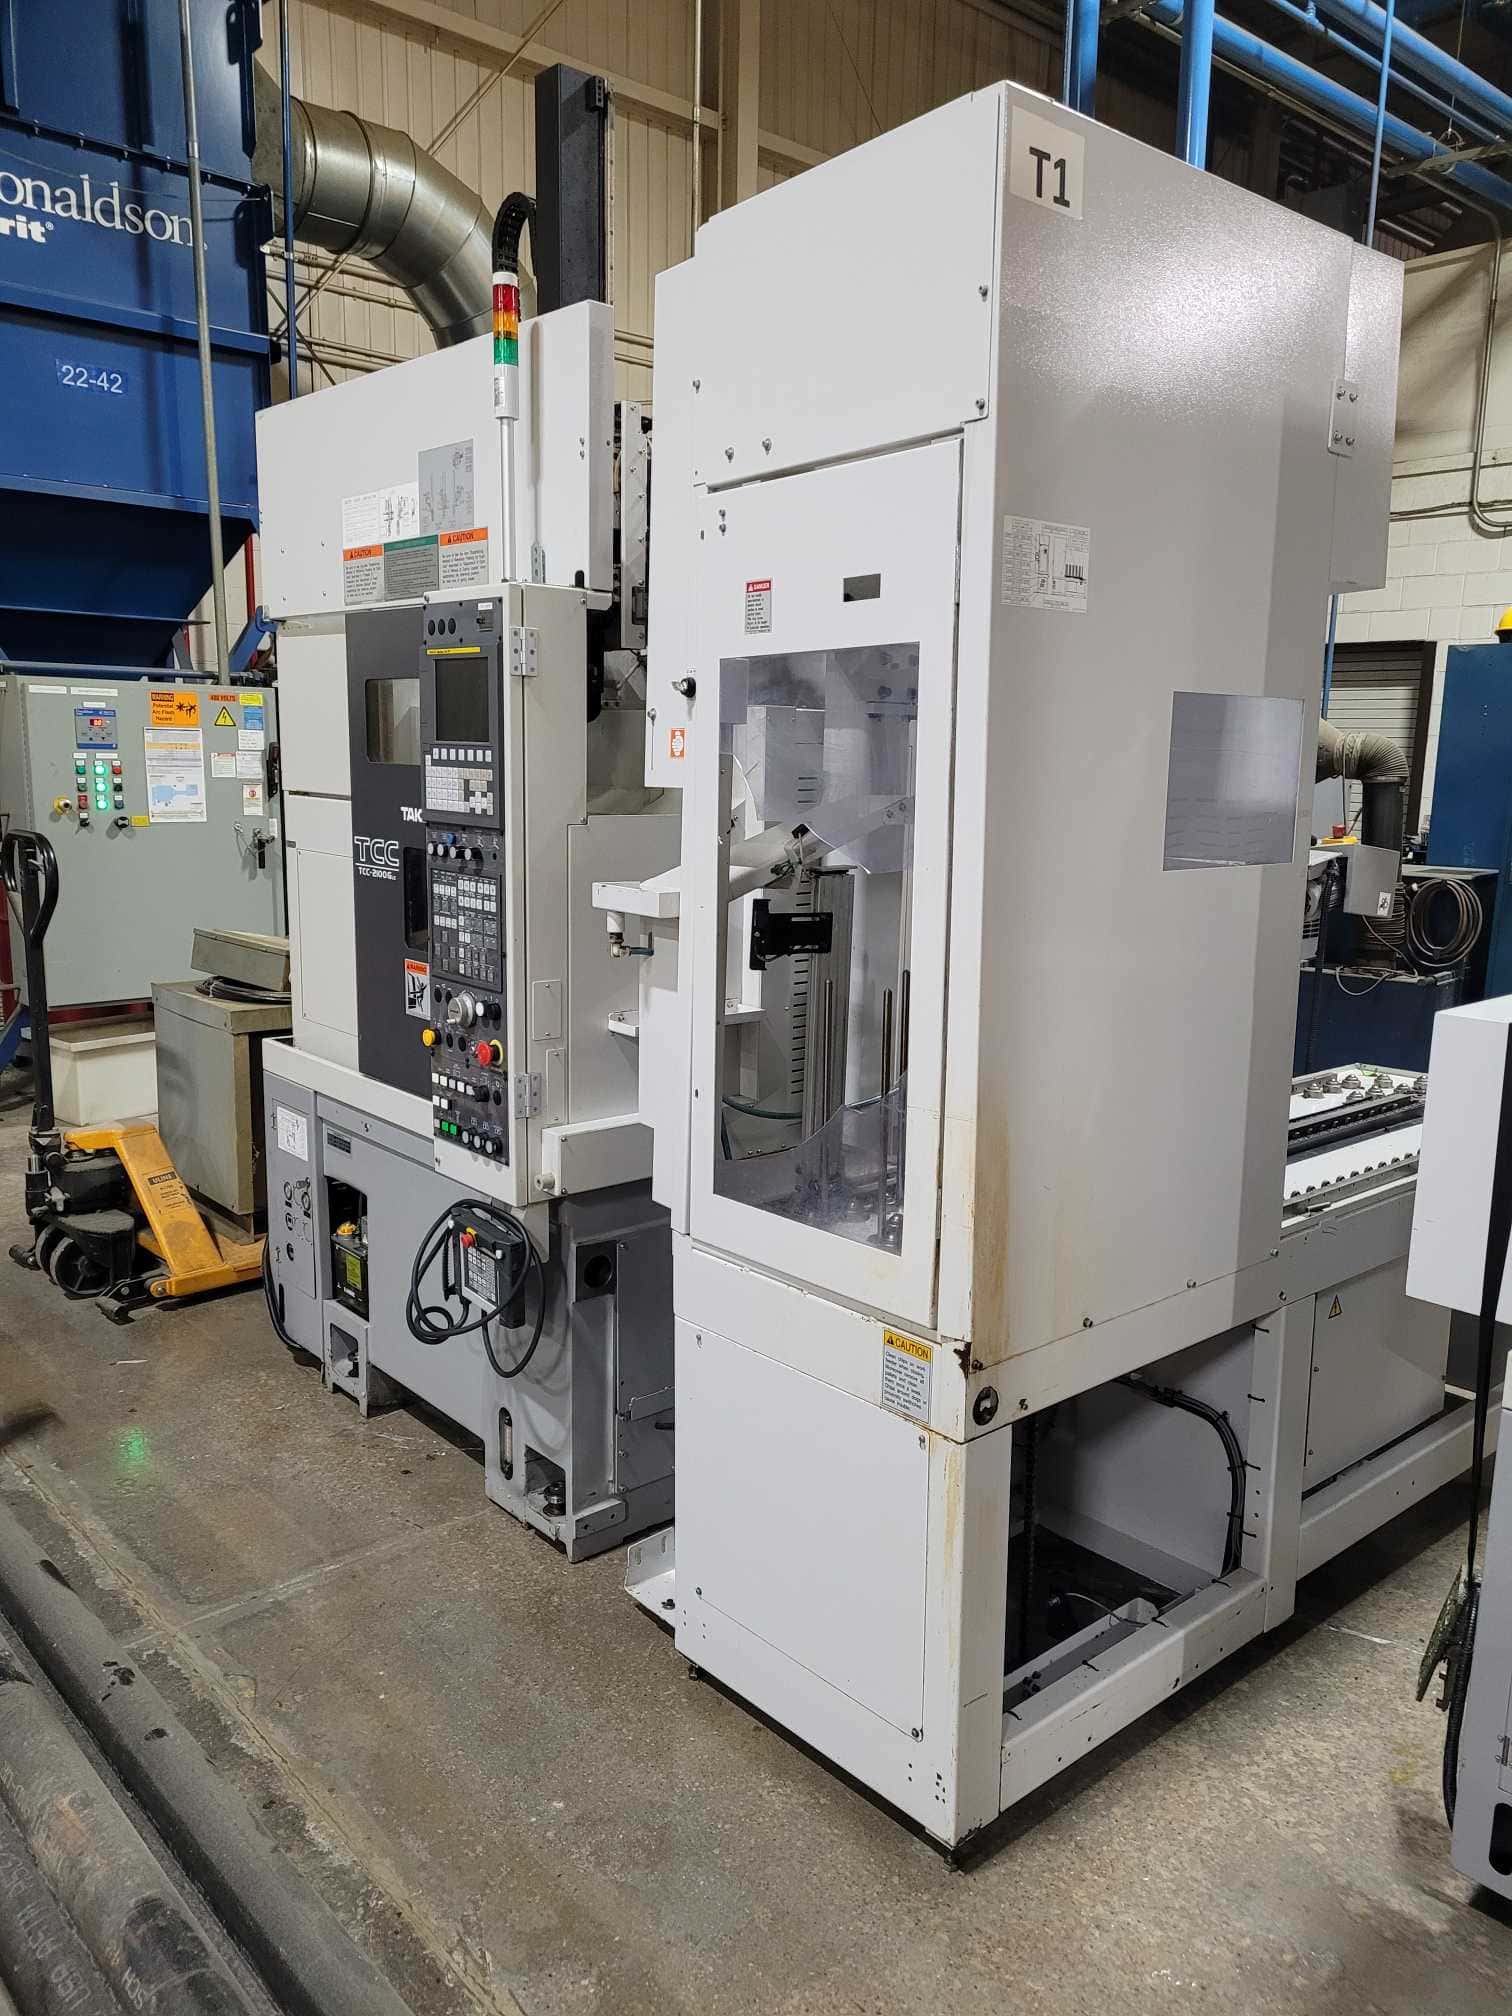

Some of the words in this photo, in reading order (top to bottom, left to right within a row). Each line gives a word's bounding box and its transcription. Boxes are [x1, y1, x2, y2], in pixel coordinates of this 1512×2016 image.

[1029, 146, 1070, 208] T1
[61, 365, 123, 394] 22-42
[354, 835, 400, 868] TCC
[895, 1338, 929, 1359] CAUTION
[121, 1965, 145, 2011] SCH
